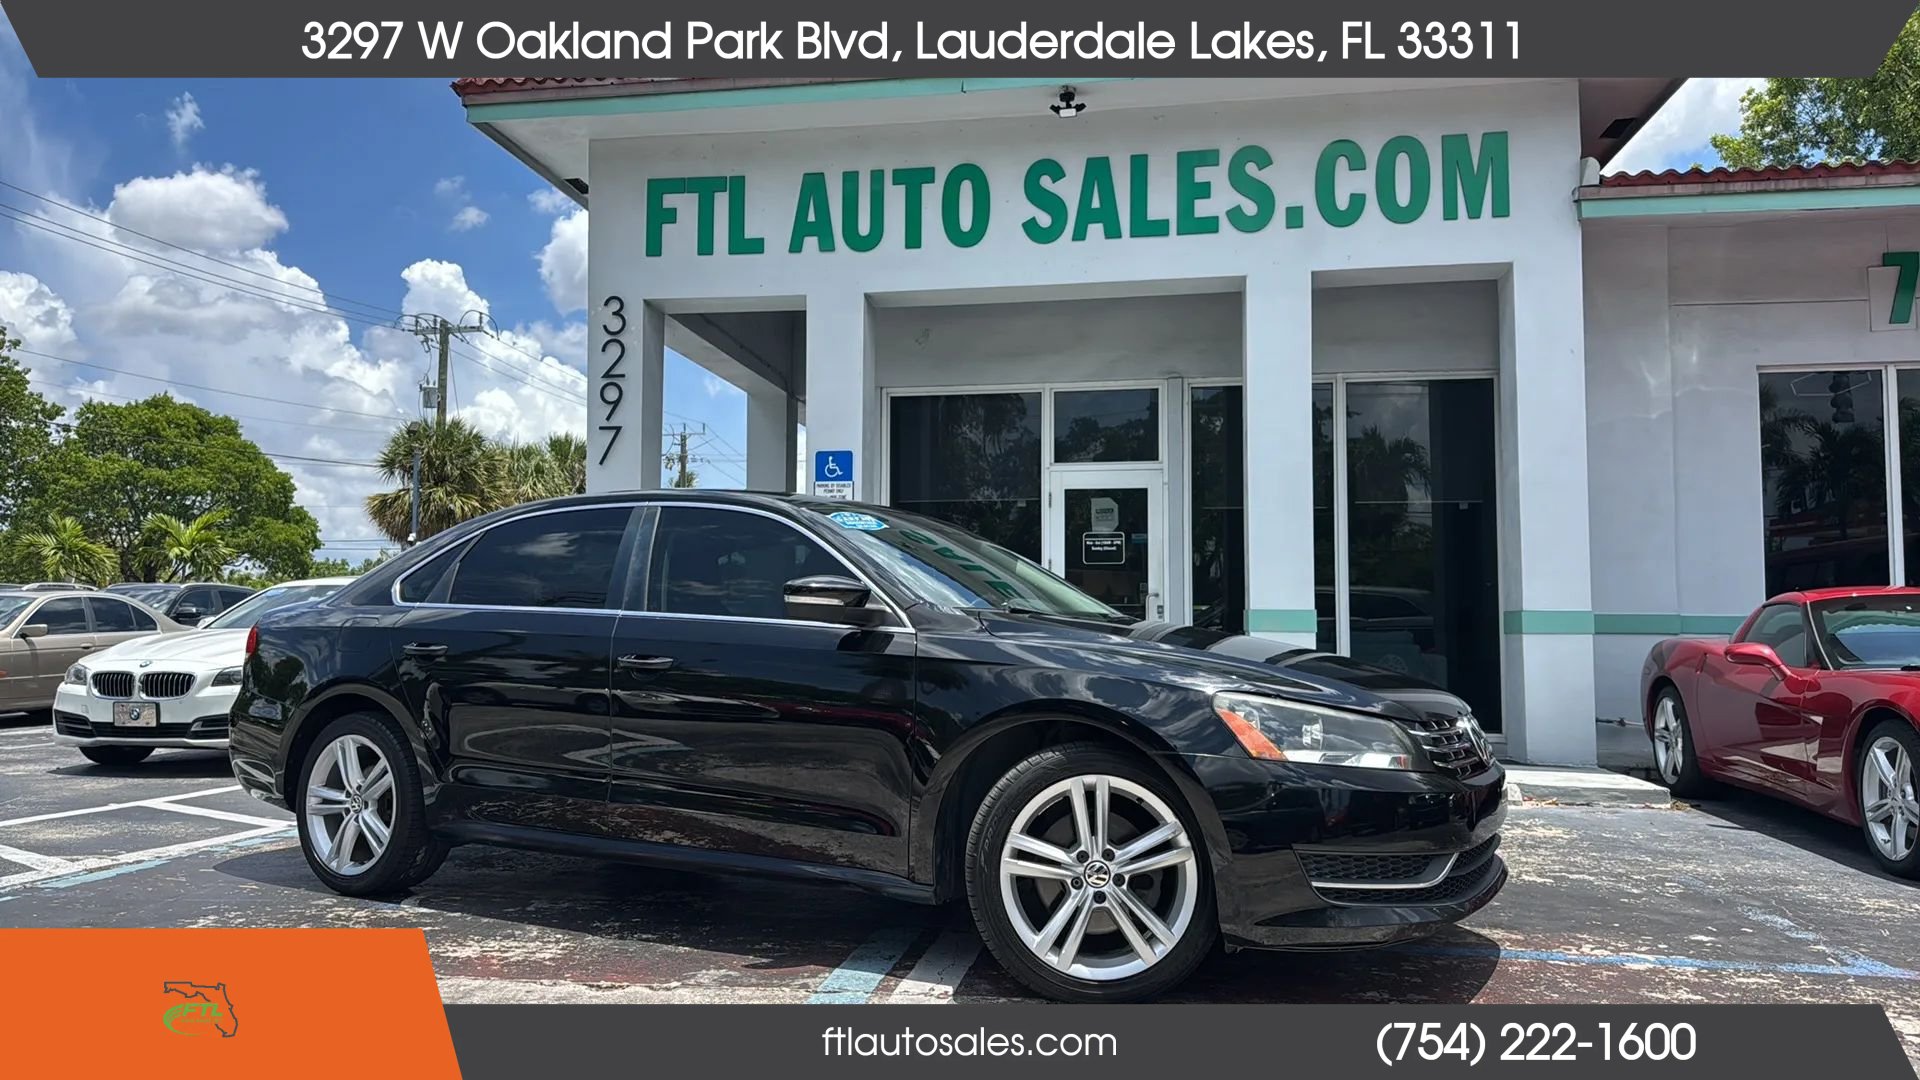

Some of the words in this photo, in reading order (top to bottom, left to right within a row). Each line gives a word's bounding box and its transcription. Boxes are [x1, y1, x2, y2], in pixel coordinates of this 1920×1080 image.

[645, 175, 765, 257] FTL
[789, 163, 991, 254] AUTO
[1022, 131, 1511, 245] SALES.COM
[598, 295, 627, 466] 3297
